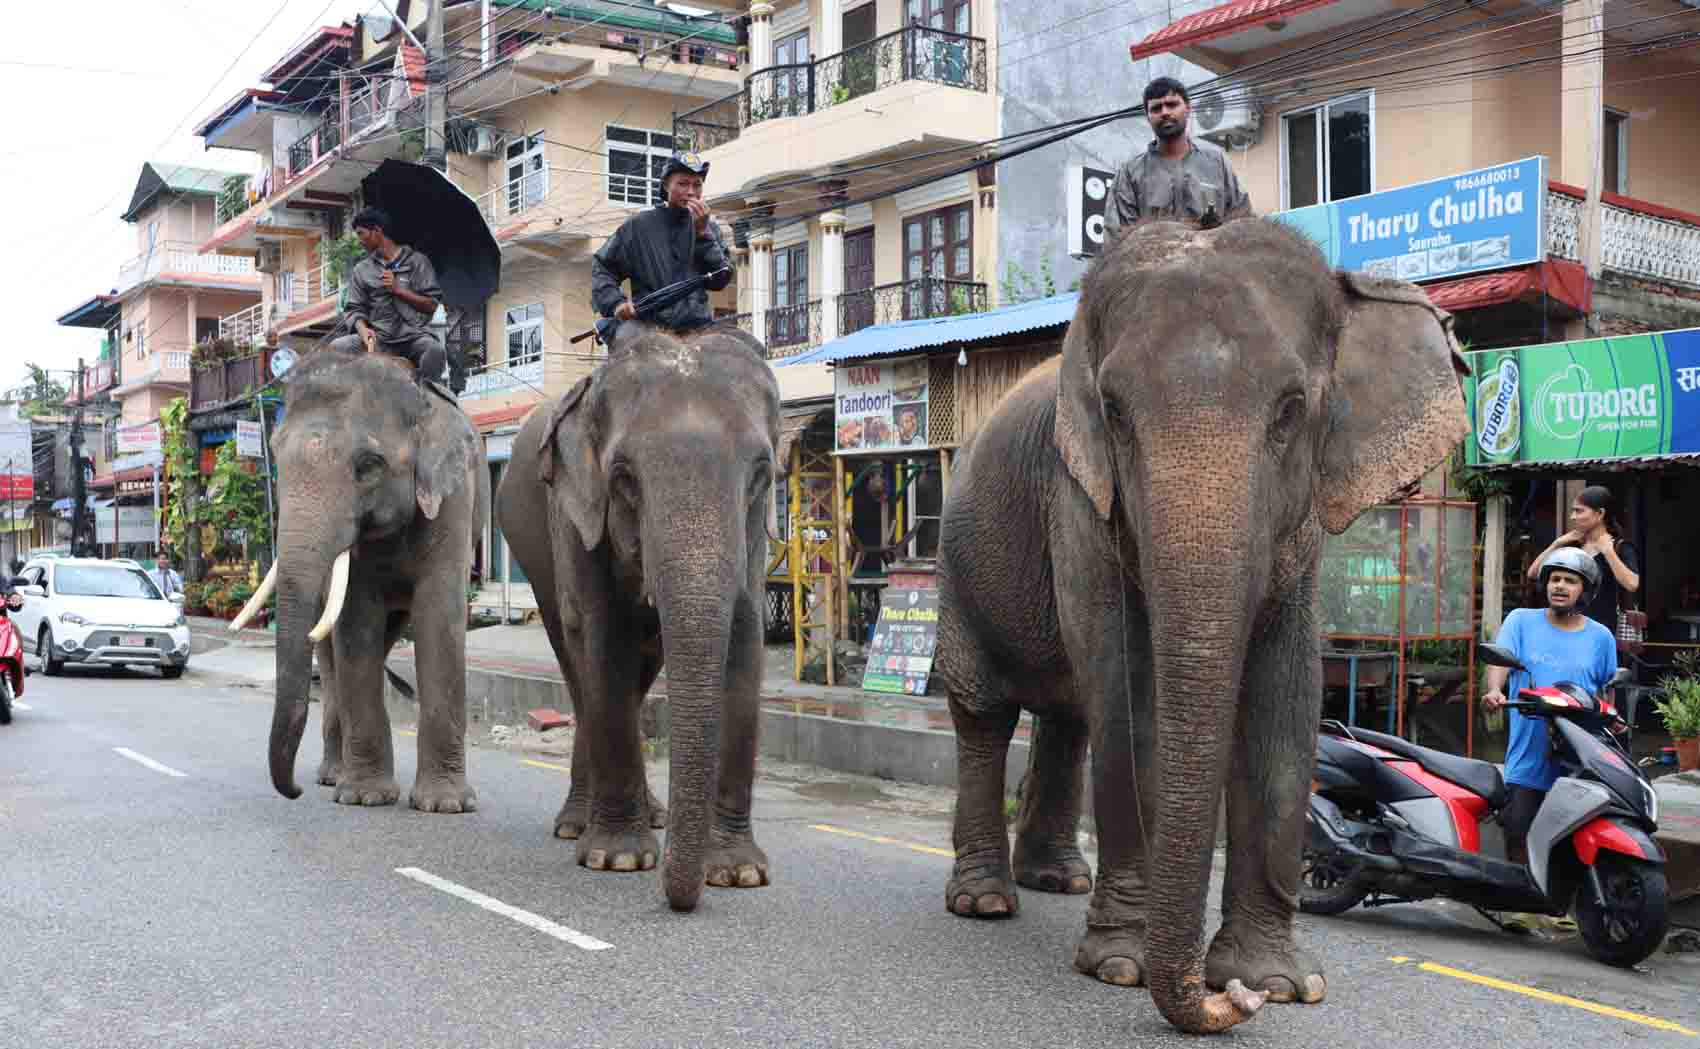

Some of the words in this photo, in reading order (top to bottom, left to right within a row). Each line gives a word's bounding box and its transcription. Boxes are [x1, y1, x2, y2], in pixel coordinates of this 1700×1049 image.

[1347, 211, 1420, 244] Tharu
[1428, 186, 1524, 229] Chulha
[848, 366, 881, 385] NAAN
[838, 389, 892, 415] Tandoori
[1481, 378, 1515, 447] TUBORG
[1550, 383, 1656, 424] TUBORG
